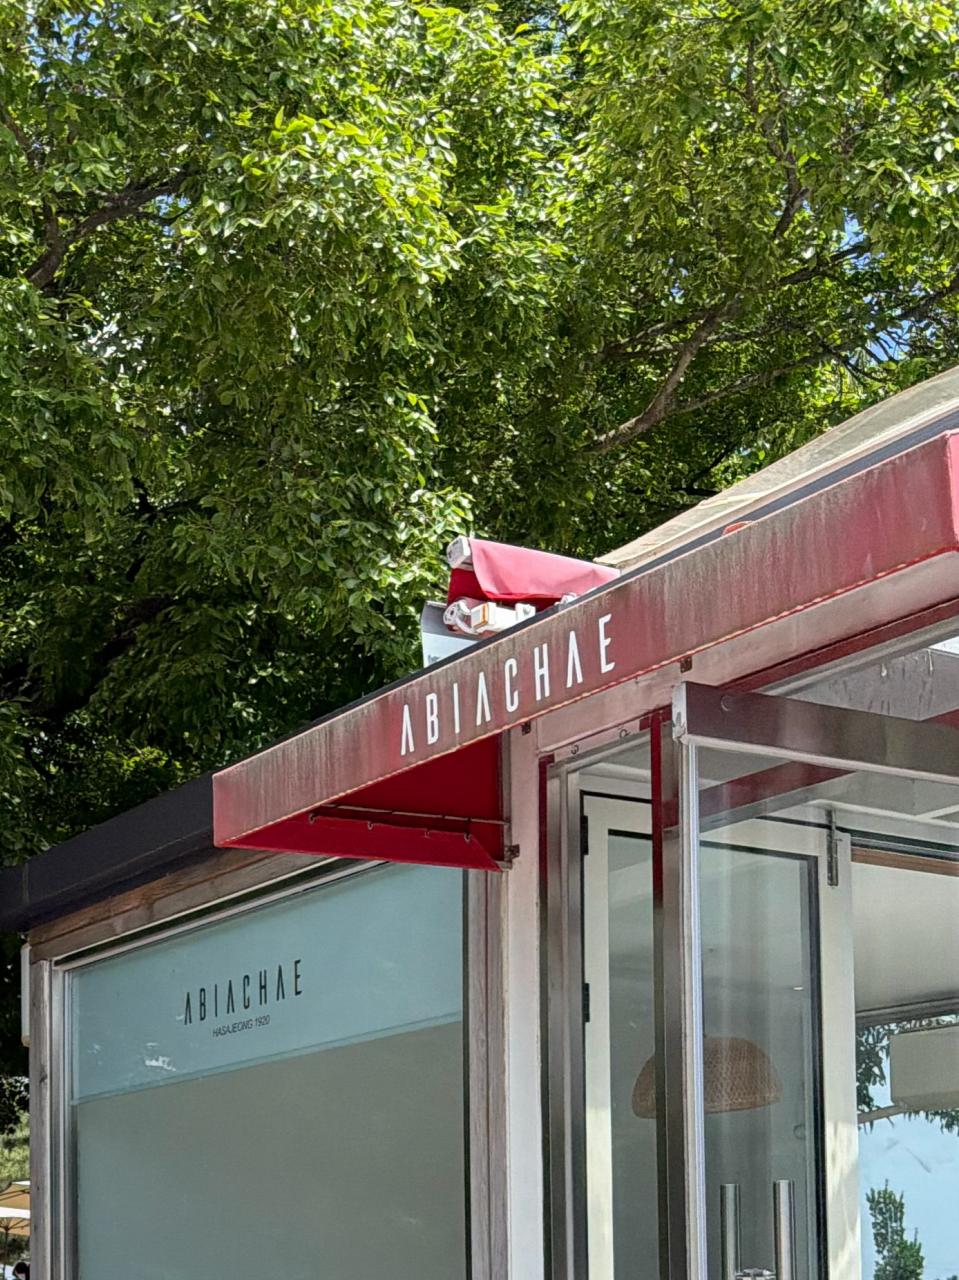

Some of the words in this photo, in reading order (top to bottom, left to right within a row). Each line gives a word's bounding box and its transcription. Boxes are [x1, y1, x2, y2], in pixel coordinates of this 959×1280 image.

[400, 613, 616, 757] ABIACHAE
[183, 959, 303, 1026] ABIACHAE
[255, 1014, 270, 1027] 1920
